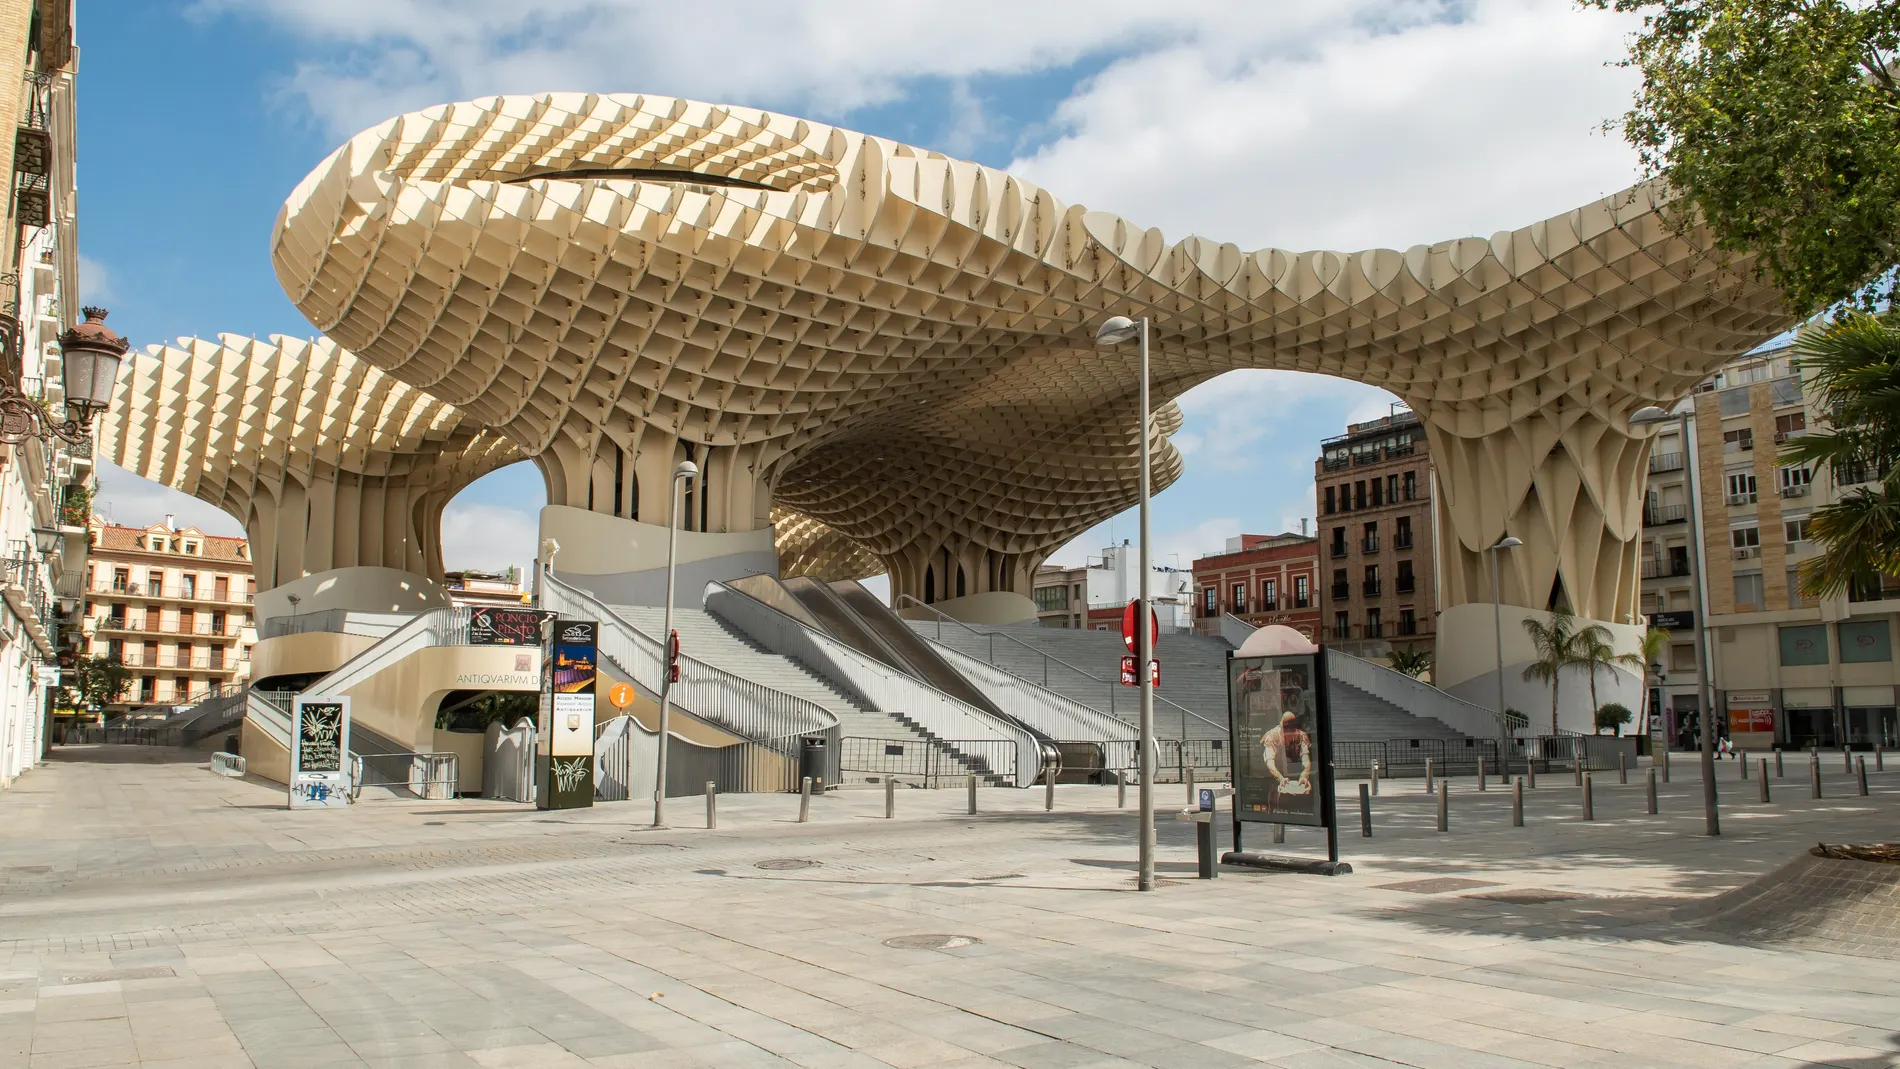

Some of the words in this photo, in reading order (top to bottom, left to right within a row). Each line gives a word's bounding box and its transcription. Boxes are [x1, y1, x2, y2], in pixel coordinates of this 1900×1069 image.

[495, 612, 538, 624] PONCIO
[498, 623, 535, 641] PILATO
[456, 674, 528, 685] ANTIQVARIVM
